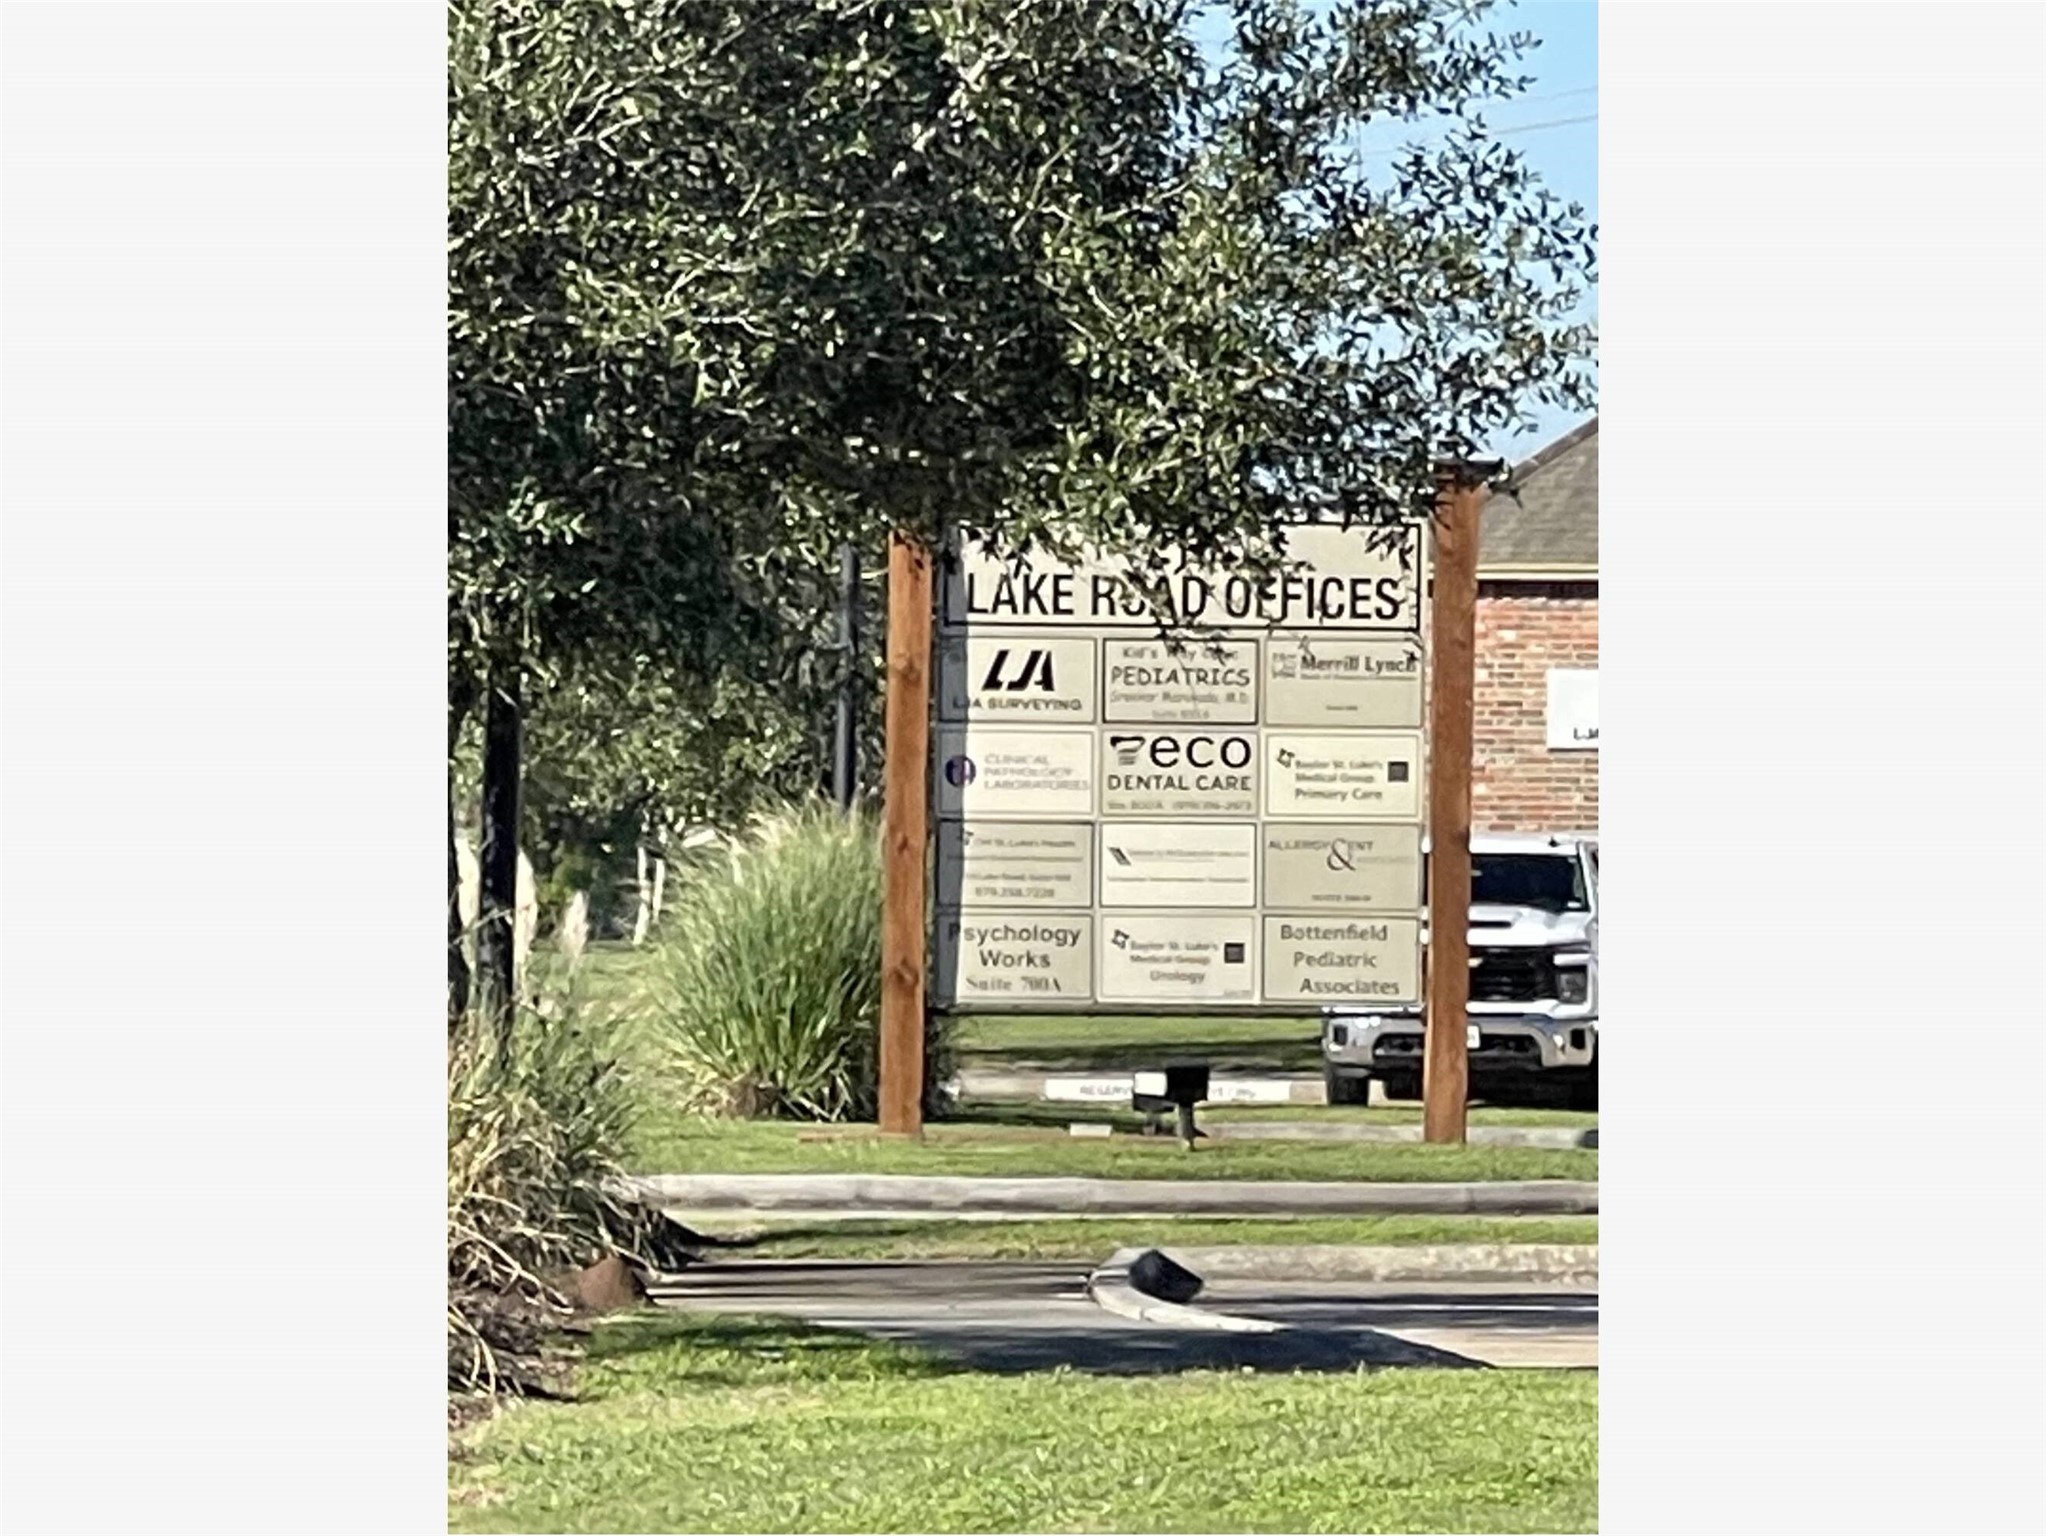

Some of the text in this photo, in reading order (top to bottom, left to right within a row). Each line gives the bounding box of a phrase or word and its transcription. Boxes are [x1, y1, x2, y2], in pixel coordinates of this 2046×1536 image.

[967, 573, 1074, 616] LAKE
[1226, 576, 1400, 621] OFFICES
[1301, 654, 1360, 671] Merrill
[1112, 665, 1251, 687] PEDIATRICS
[988, 698, 1082, 711] SURVEYING
[1150, 736, 1251, 768] eco
[1107, 774, 1252, 791] DENTAL CARE
[1327, 837, 1357, 872] &
[948, 924, 1082, 947] Psychology
[1280, 924, 1389, 941] Bottenfield
[979, 949, 1051, 968] Works
[1293, 951, 1378, 968] Pediatric
[1299, 978, 1401, 995] Associates
